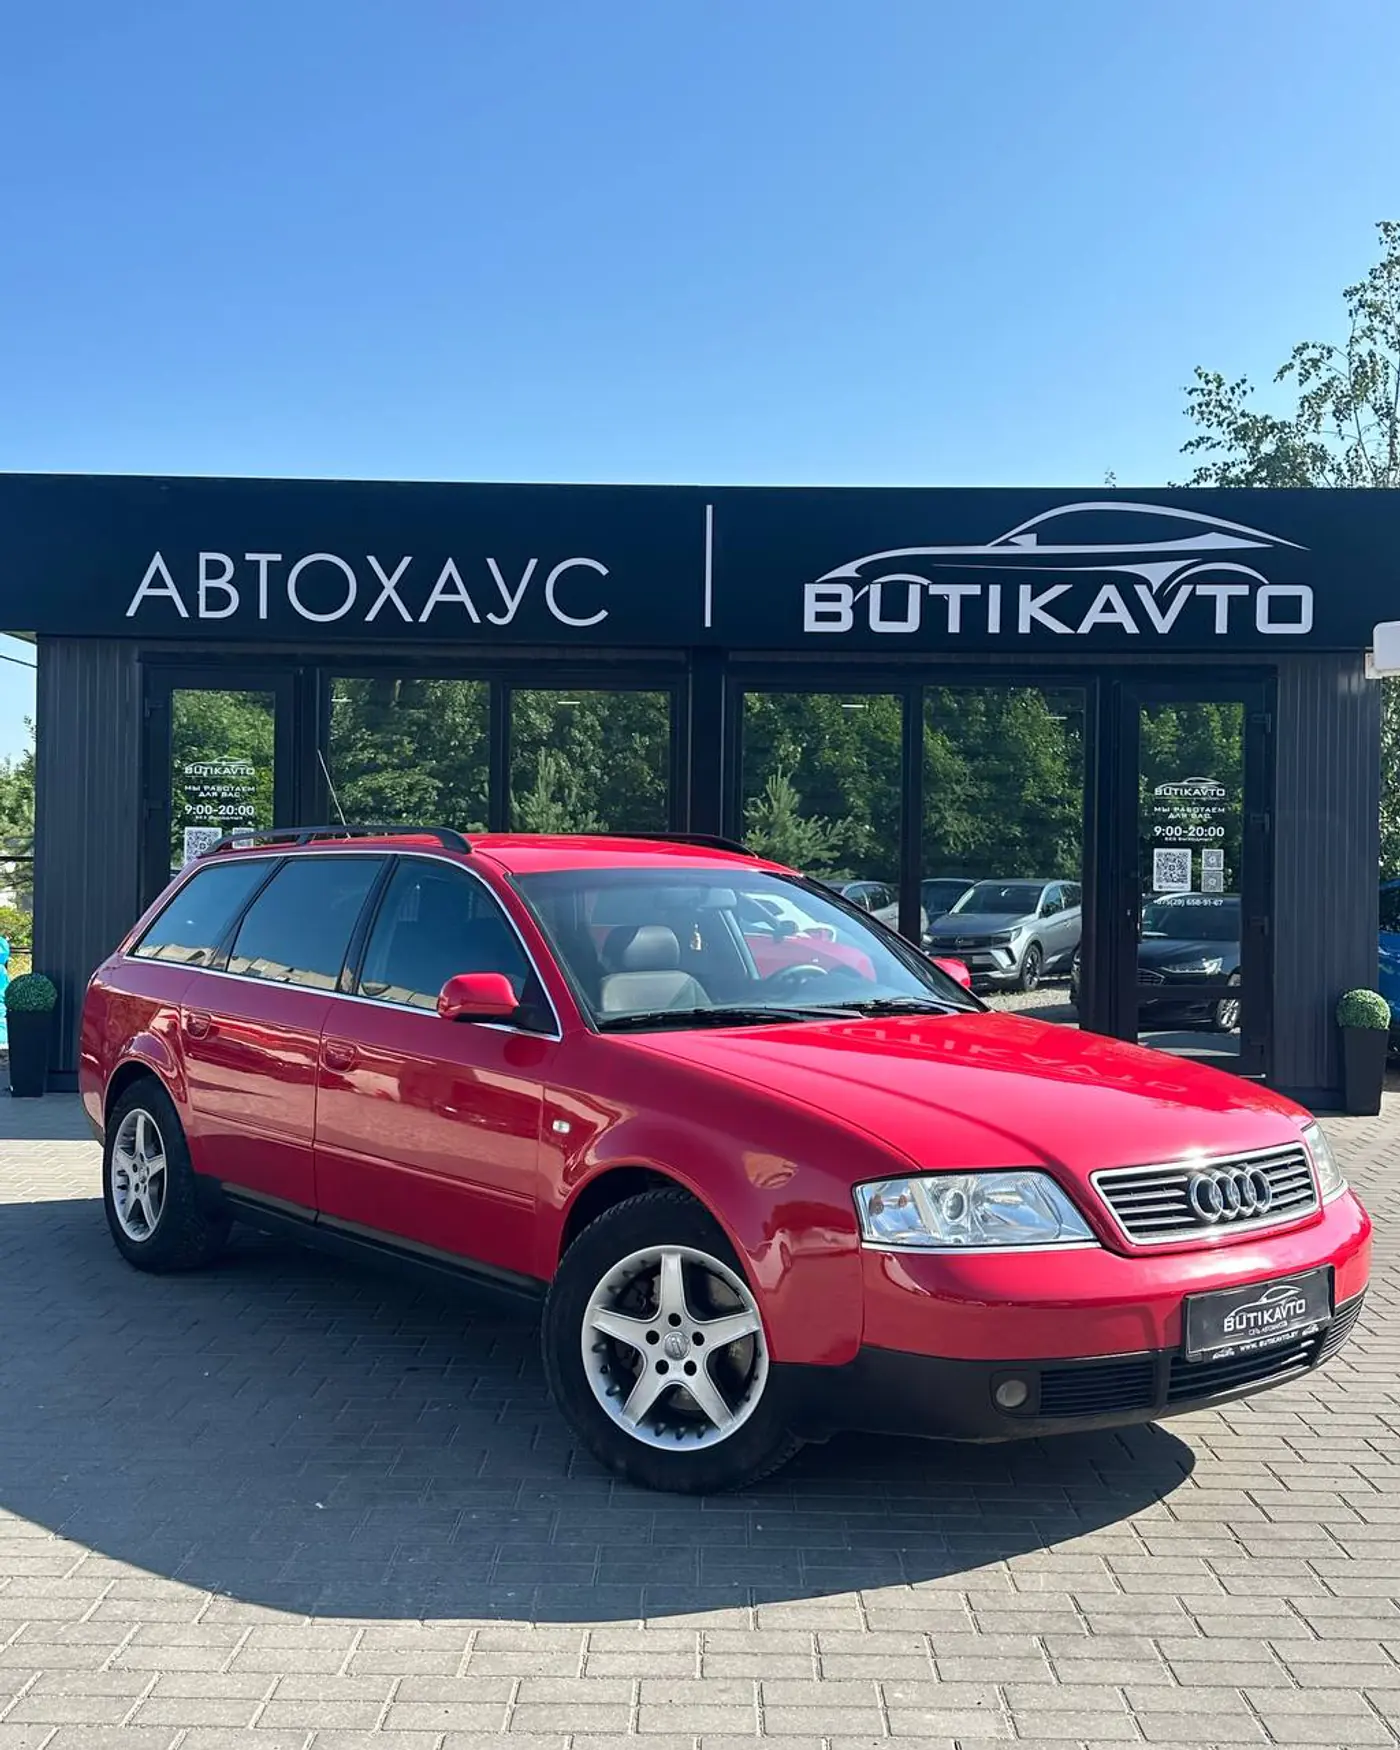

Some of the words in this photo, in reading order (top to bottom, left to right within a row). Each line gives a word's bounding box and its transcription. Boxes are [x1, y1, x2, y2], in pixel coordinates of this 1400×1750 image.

[126, 551, 610, 626] АВТОХАУС
[804, 583, 1314, 635] BUTIKAVTO
[185, 766, 255, 775] BUTIKAVTO
[1154, 787, 1225, 796] BUTIKAVTO
[184, 804, 254, 816] 9:00-20:00
[1154, 826, 1224, 837] 9:00-20:00
[1224, 1299, 1306, 1332] BUTIKAVTO
